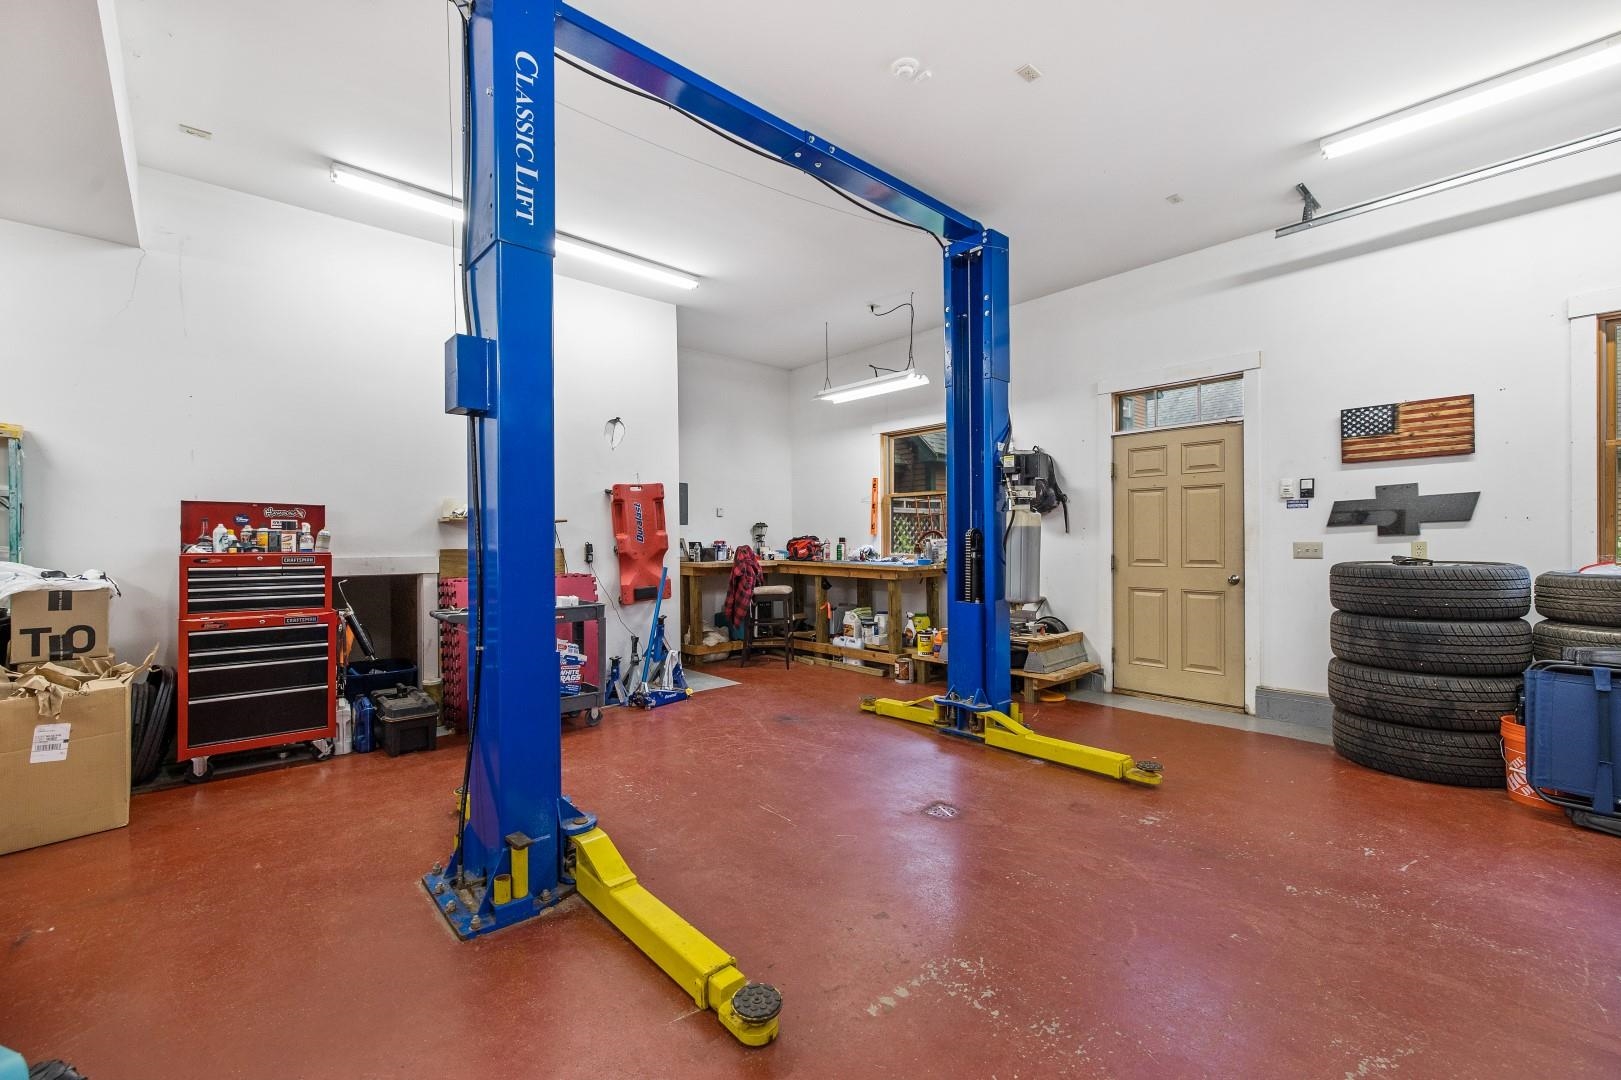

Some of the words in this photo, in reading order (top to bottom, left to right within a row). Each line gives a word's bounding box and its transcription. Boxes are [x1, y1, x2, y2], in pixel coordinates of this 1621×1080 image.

[515, 51, 539, 163] CLASSIC
[515, 162, 539, 226] LIFT
[633, 501, 645, 544] Duralast
[283, 556, 315, 564] CRAFTSMAN
